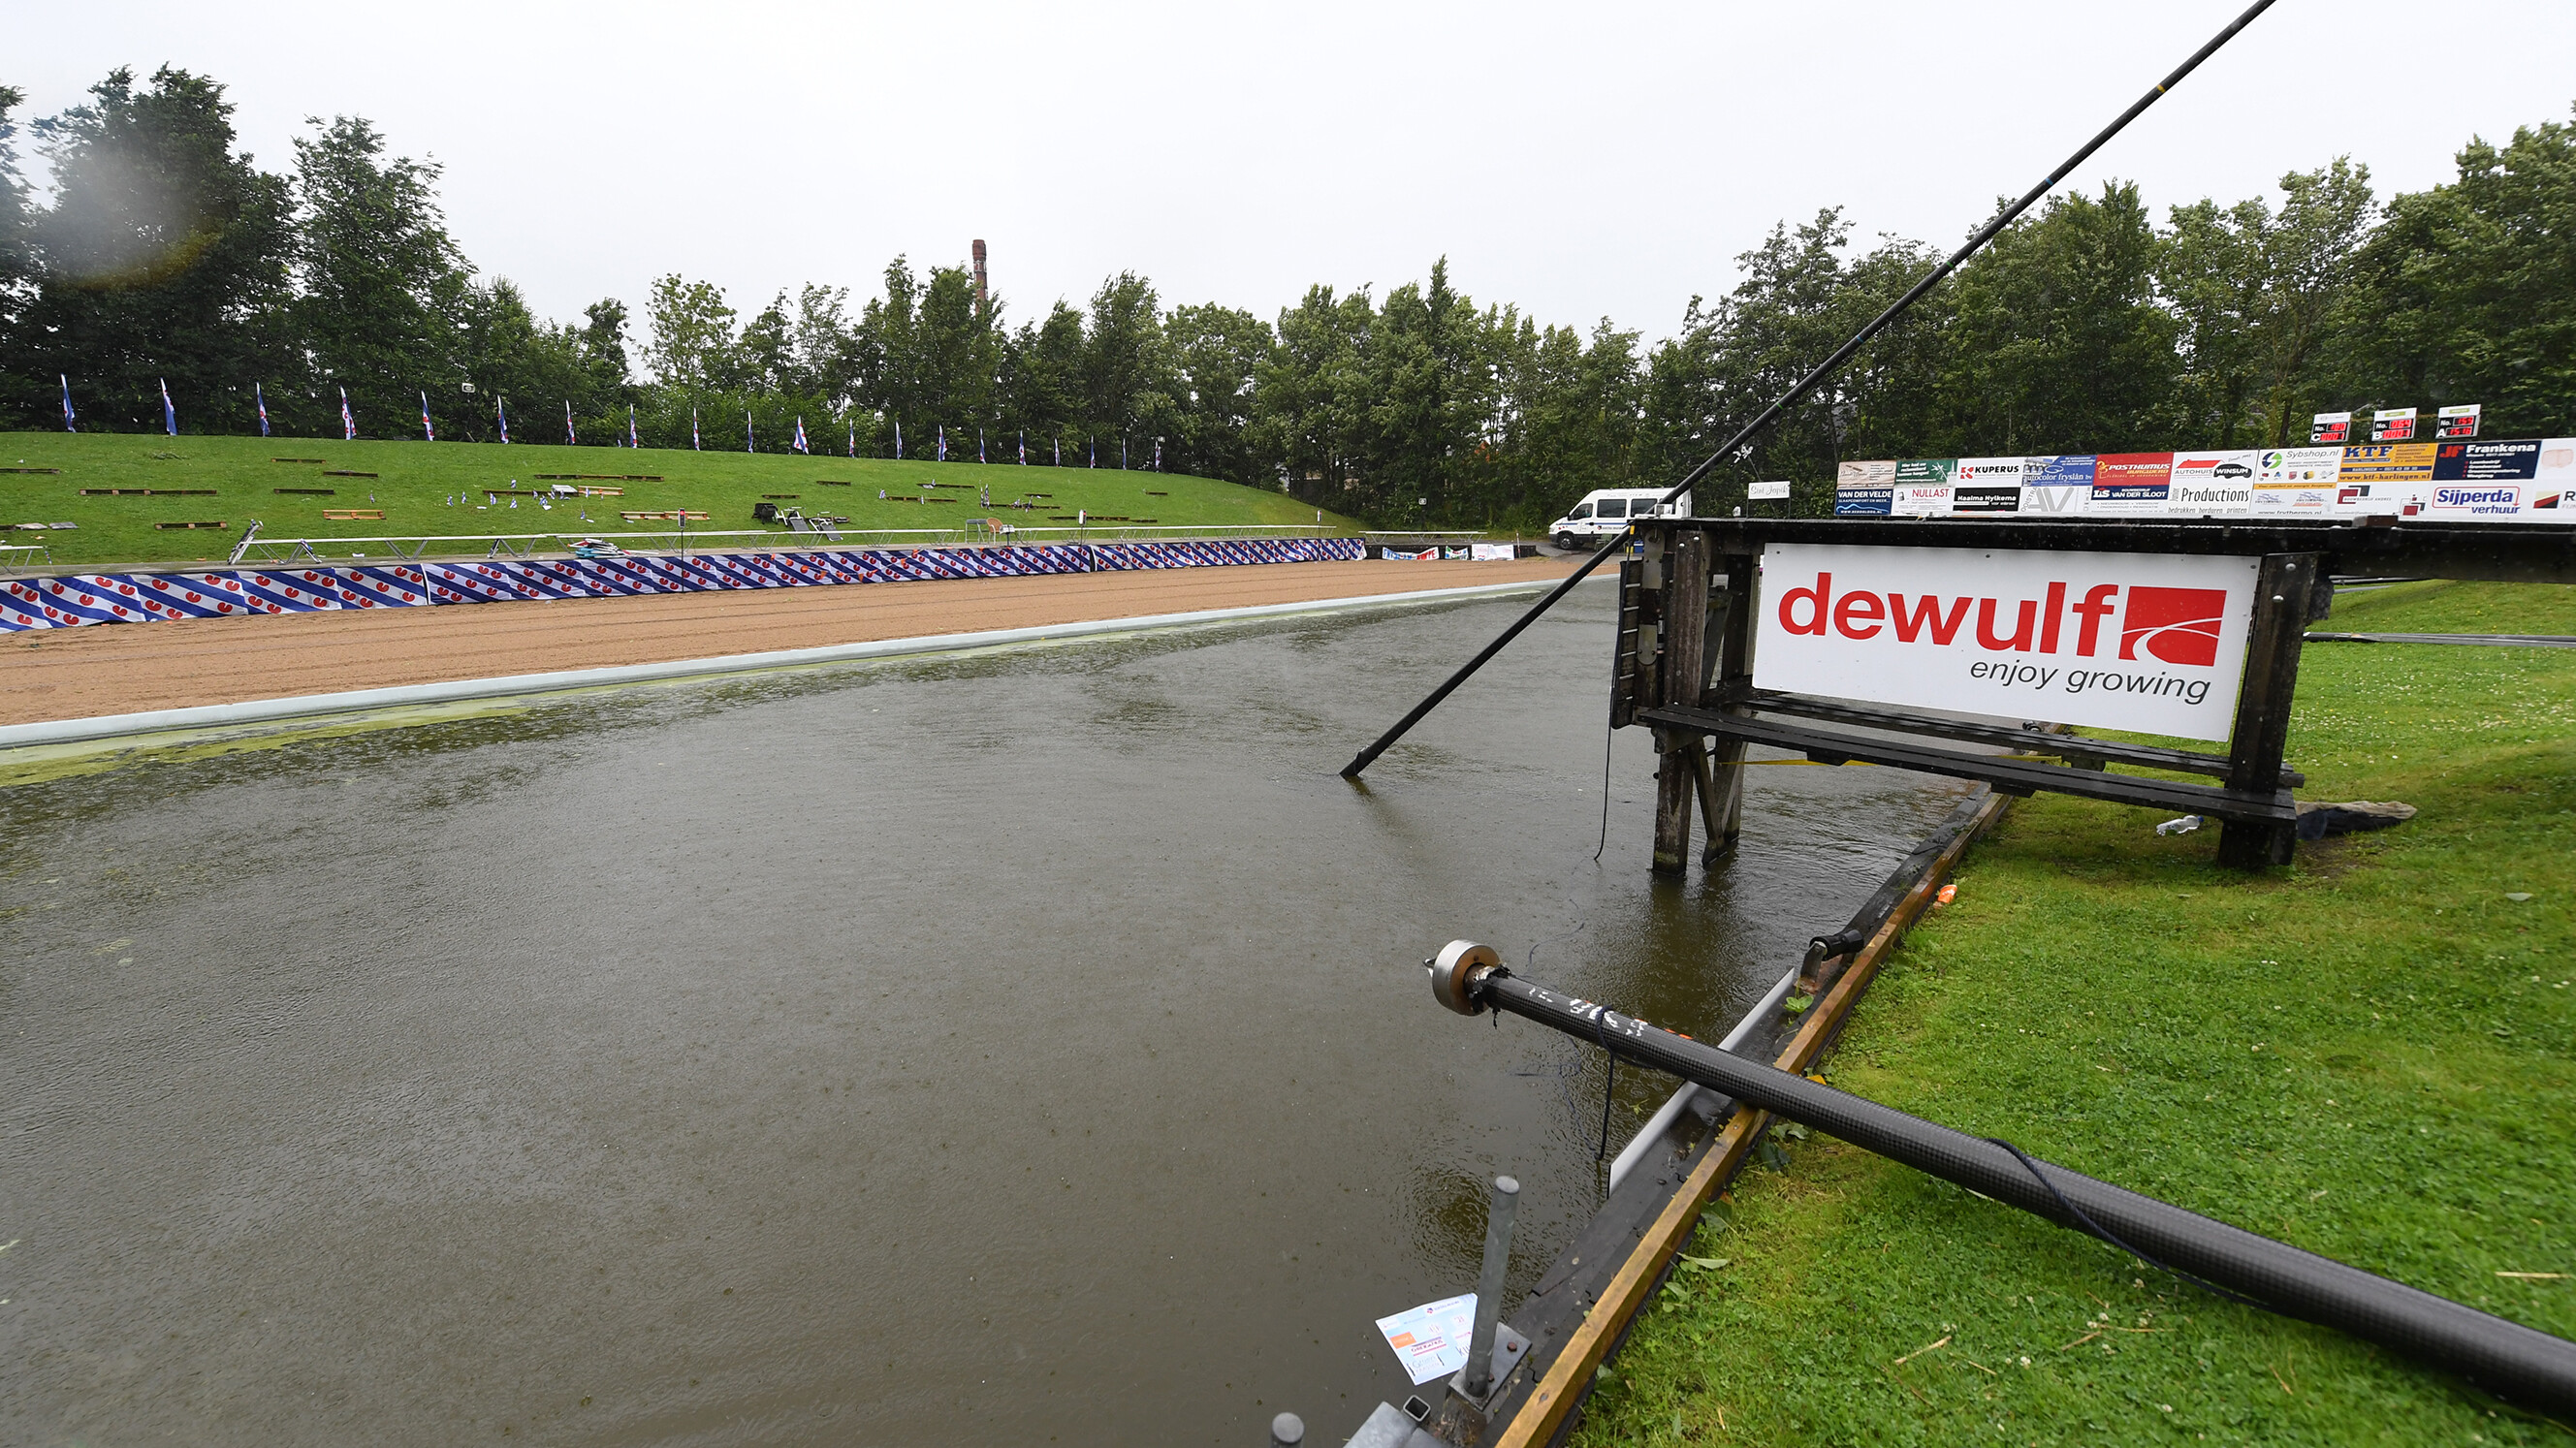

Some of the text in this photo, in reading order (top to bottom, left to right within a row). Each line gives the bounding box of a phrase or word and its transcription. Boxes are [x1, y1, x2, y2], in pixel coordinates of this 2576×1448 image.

[2311, 433, 2321, 441] C
[2372, 429, 2411, 440] B 0001
[2436, 428, 2447, 438] A
[2286, 449, 2339, 459] Sybshop.nl
[2343, 446, 2393, 458] KTF
[2466, 443, 2537, 454] Frankena
[1975, 465, 2019, 473] KUPERUS
[1912, 488, 1950, 498] NULLAST
[2181, 487, 2250, 502] Productions
[2437, 489, 2513, 505] Sijperda
[2471, 505, 2521, 514] verhuur
[1778, 571, 2119, 658] dewulf
[1969, 660, 2211, 705] enjoy growing
